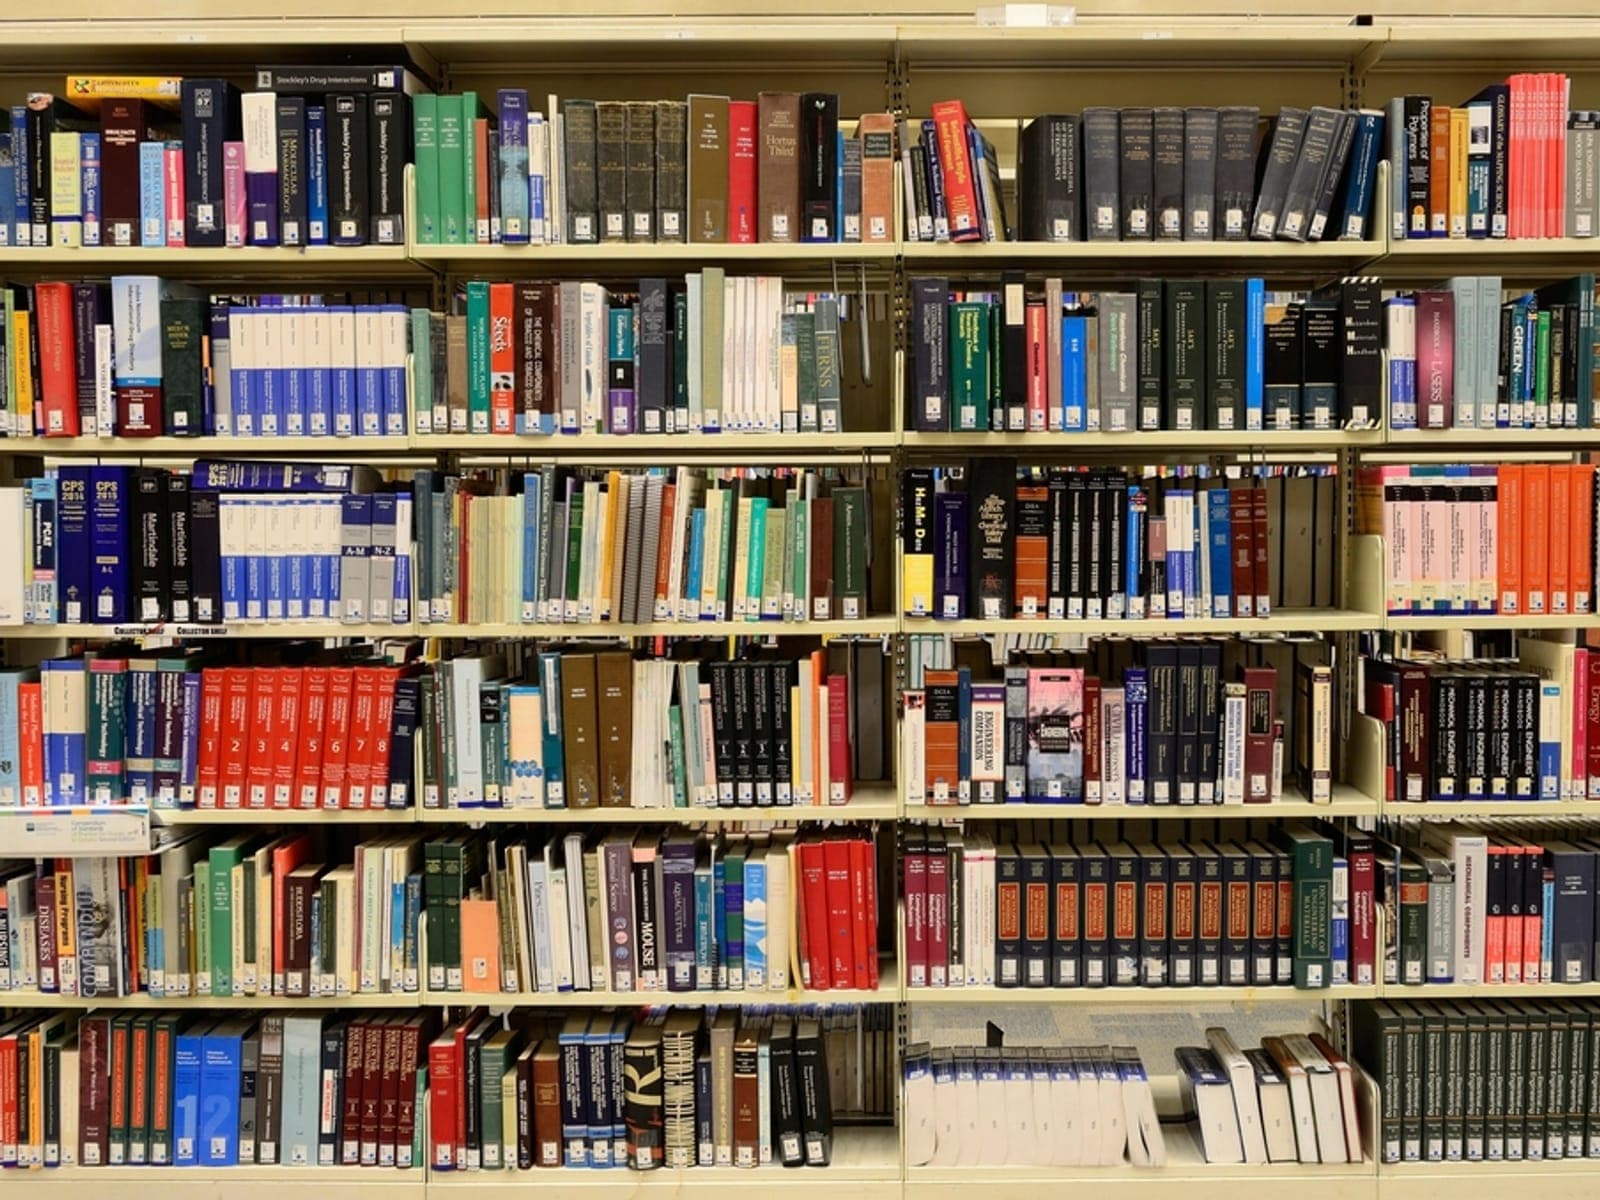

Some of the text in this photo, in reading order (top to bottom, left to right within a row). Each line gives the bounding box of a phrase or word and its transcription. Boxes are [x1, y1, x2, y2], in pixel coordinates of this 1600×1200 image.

[277, 76, 308, 85] Stockley's
[310, 76, 327, 87] Drug
[379, 120, 388, 152] Stockley's
[766, 134, 796, 146] Hortus
[1408, 115, 1419, 160] Polymers
[1420, 100, 1430, 160] Properties of
[342, 118, 353, 210] Stockley's Drug Interactions
[380, 153, 389, 171] Drug
[769, 146, 795, 156] Third
[952, 120, 966, 184] Scientific Style
[494, 316, 508, 352] Seeds
[1513, 326, 1524, 373] GREEN
[53, 344, 62, 371] Drugs
[534, 316, 542, 401] THE CHEMICAL COMPONENTS
[818, 335, 832, 387] FERNS
[1430, 361, 1442, 401] LASERS
[62, 480, 84, 492] CPS
[96, 481, 118, 492] CPS
[42, 521, 52, 547] PCAT
[147, 512, 158, 567] Martindale
[176, 512, 187, 566] Martindale
[915, 488, 926, 552] HazMat Data
[344, 546, 368, 556] A-M
[374, 546, 393, 556] N-Z
[1111, 703, 1121, 735] CIVIL
[1448, 688, 1456, 728] MECHANICAL
[1477, 690, 1485, 730] MECHANICAL
[1501, 690, 1510, 730] MECHANICAL
[1525, 689, 1533, 730] MECHANICAL
[1588, 686, 1600, 724] Energy
[98, 722, 107, 757] Technology
[135, 721, 144, 755] Technology
[164, 721, 173, 755] Technology
[207, 741, 214, 750] 1
[232, 740, 240, 752] 2
[258, 741, 265, 752] 3
[282, 741, 289, 752] 4
[309, 741, 318, 752] 5
[333, 741, 341, 753] 6
[356, 739, 363, 750] 7
[379, 740, 386, 752] 8
[975, 710, 984, 760] COMPANION
[983, 710, 994, 770] ENGINEERING
[534, 881, 544, 907] Pines
[608, 851, 619, 912] Animal Science
[60, 875, 71, 946] Nursing Programs
[674, 881, 683, 944] AQUACULTURE
[1434, 886, 1442, 927] DATABOOK
[1442, 886, 1451, 922] MACHINE
[39, 905, 51, 961] DISEASES
[295, 912, 303, 940] FLORA
[641, 922, 654, 966] MOUSE
[1385, 1076, 1393, 1118] Engineering
[1406, 1074, 1414, 1116] Engineering
[1426, 1074, 1434, 1116] Engineering
[177, 1095, 197, 1139] 1
[204, 1094, 231, 1141] 2
